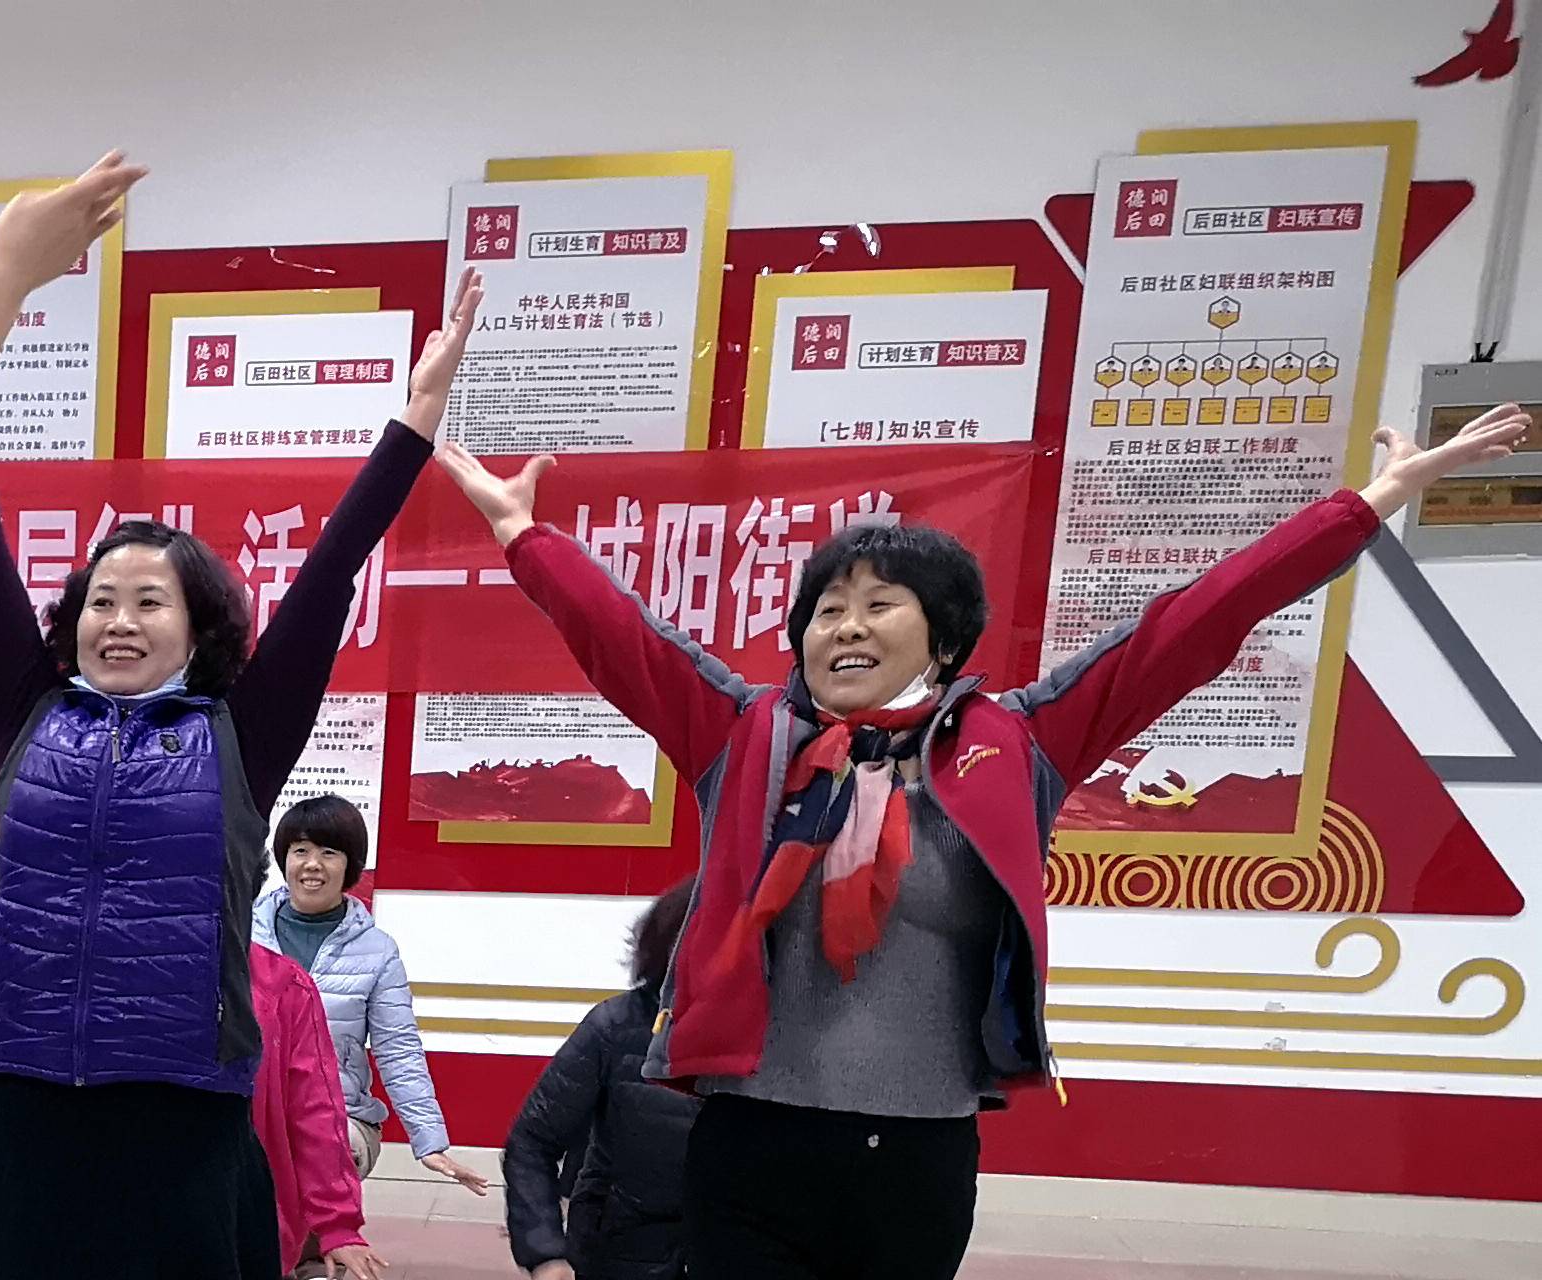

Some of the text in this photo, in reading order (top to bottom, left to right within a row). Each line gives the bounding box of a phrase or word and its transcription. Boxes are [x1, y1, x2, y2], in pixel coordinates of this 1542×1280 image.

[1193, 206, 1357, 230] 后田社区 妇联宣传
[537, 231, 682, 253] 计划生育 知识普及
[1120, 270, 1336, 294] 后田社区妇联组织架构图
[518, 292, 631, 312] 中华人民共和国
[477, 310, 664, 332] 人口与计划生育法（节选）
[867, 343, 1021, 364] 计划生育 知识普及
[251, 362, 390, 382] 后田社区 管理制度
[197, 428, 375, 447] 后田社区排练室管理规定
[820, 418, 980, 443] 【七期】知识宣传
[1106, 436, 1299, 456] 后田社区妇联工作制度
